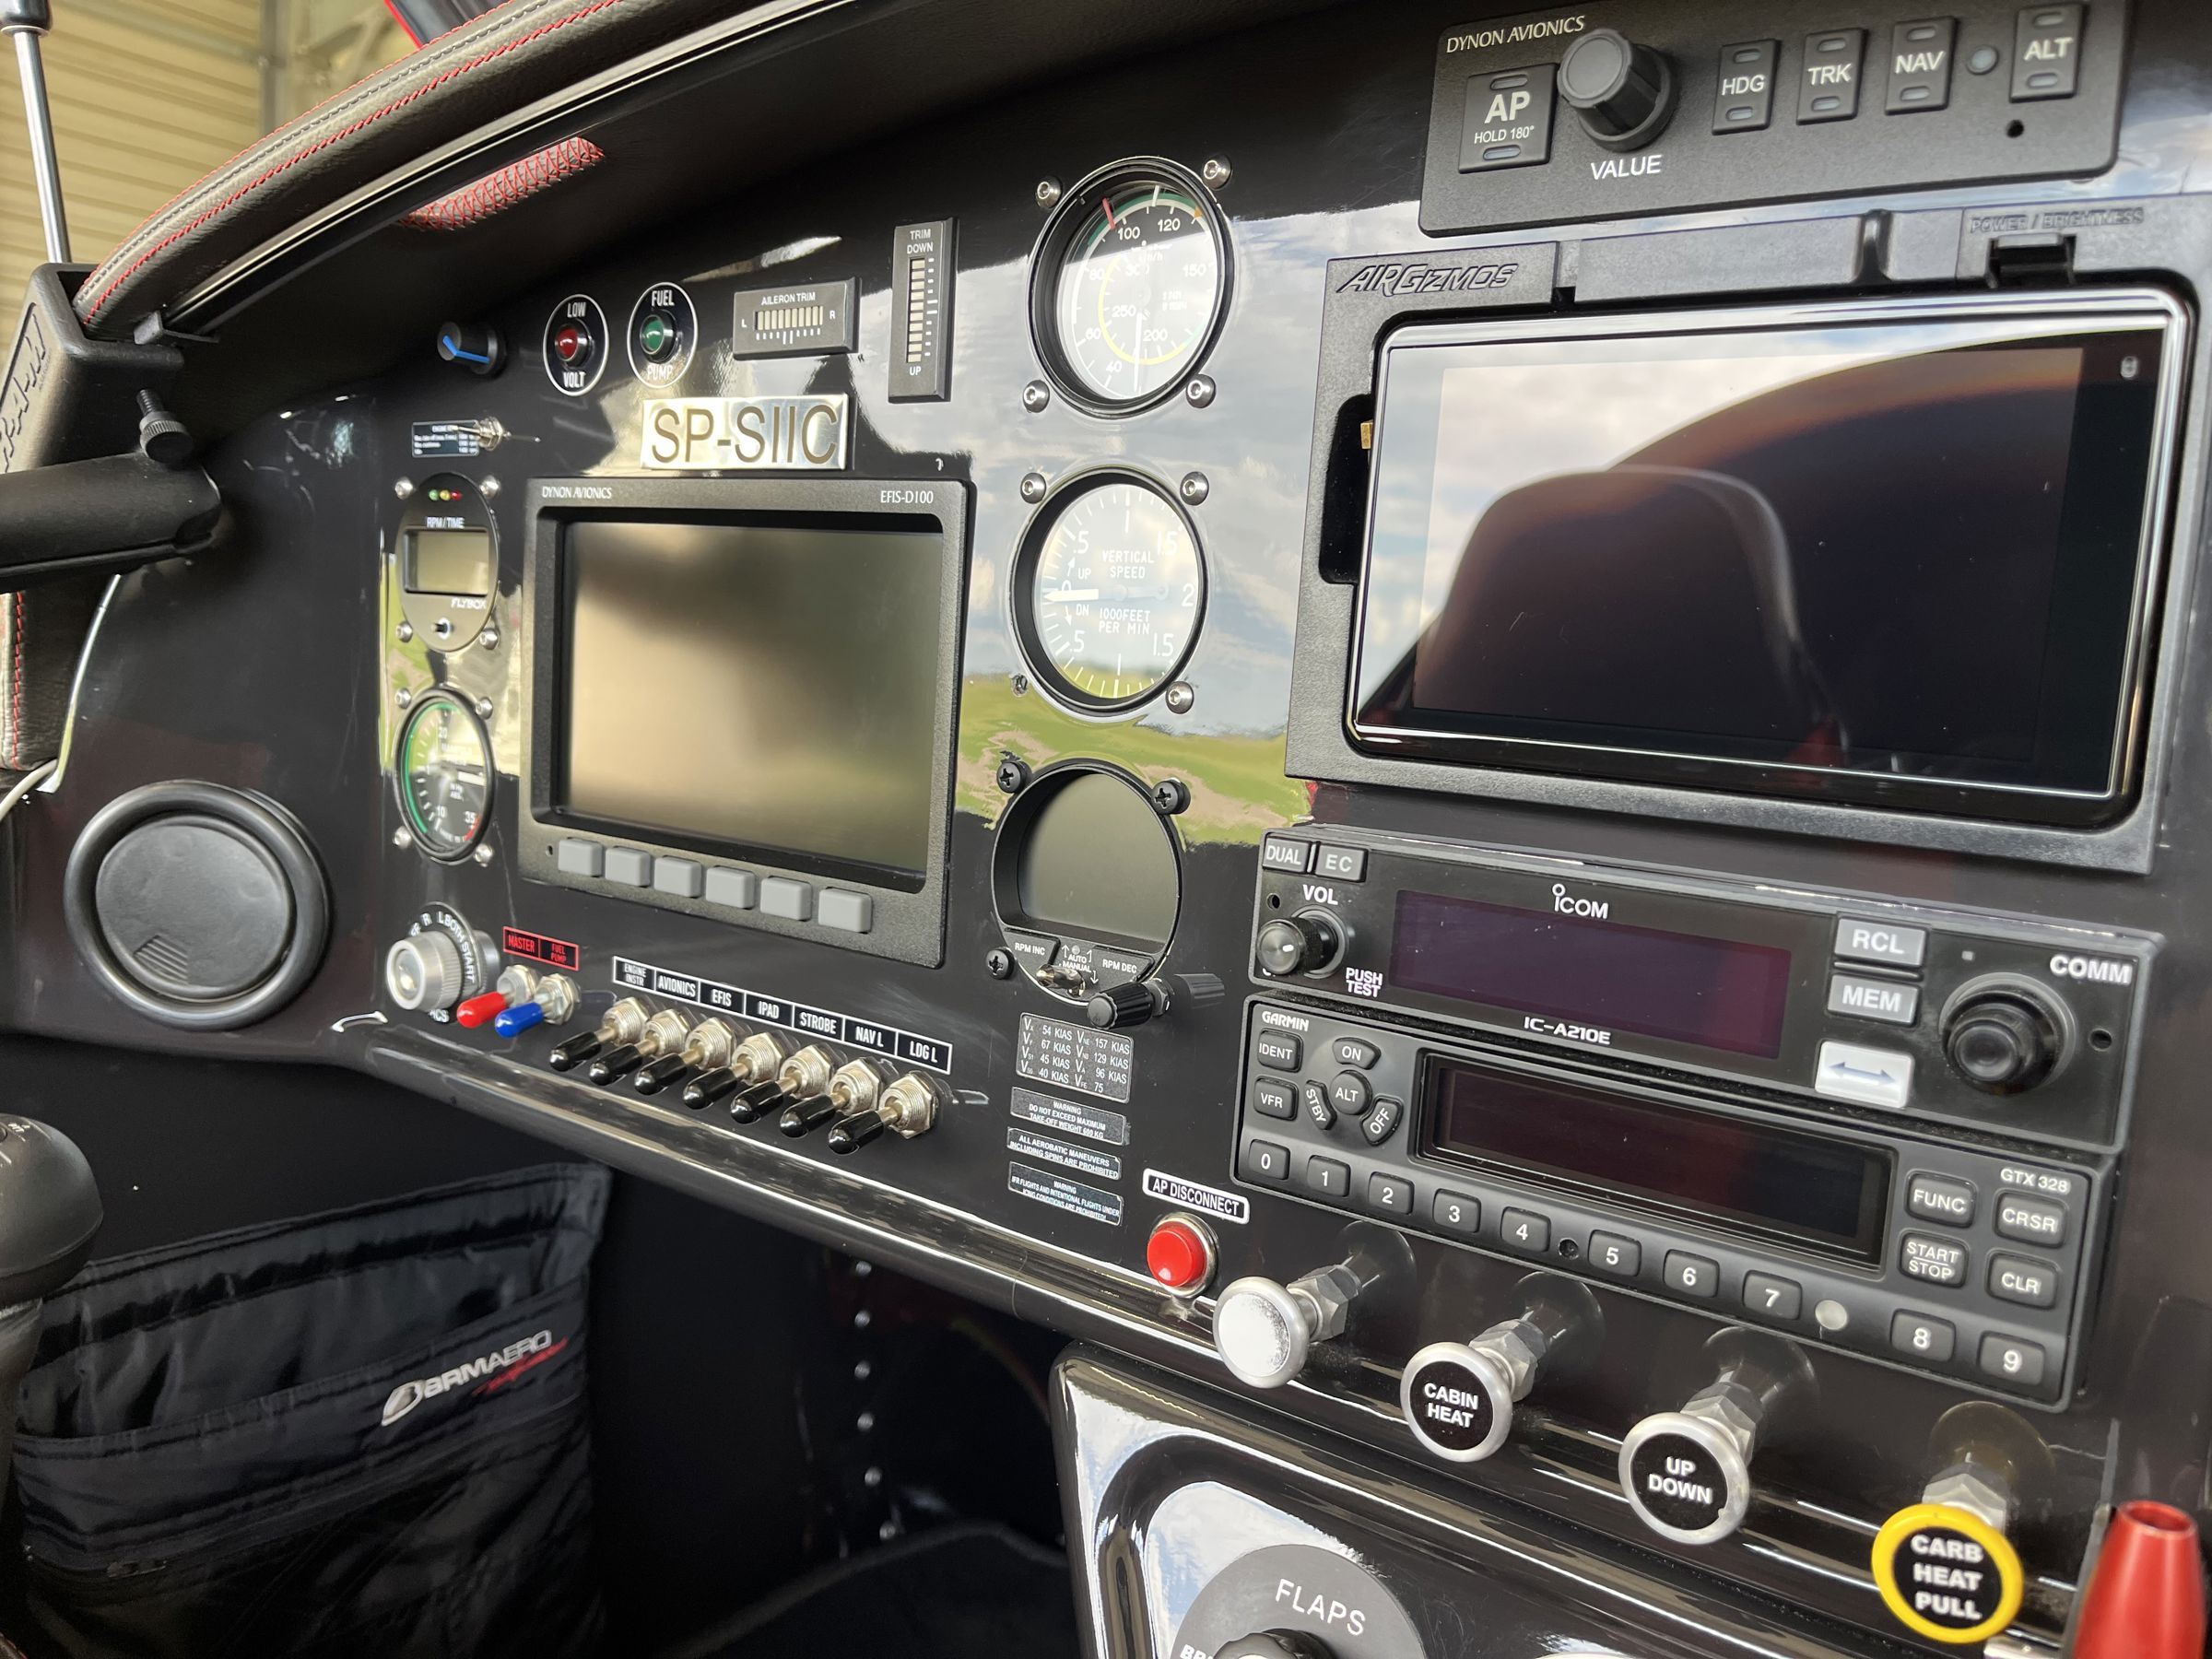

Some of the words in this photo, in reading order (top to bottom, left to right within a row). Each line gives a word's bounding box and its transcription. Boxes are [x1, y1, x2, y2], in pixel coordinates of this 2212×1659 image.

[1446, 29, 1504, 53] DYNON
[1507, 16, 1585, 44] AVIONICS
[2024, 37, 2073, 61] ALT
[1895, 51, 1946, 74] NAV
[1808, 64, 1852, 85] TRK
[1722, 75, 1765, 95] HDG
[1484, 91, 1531, 124] AP
[1474, 129, 1506, 144] HOLD
[1510, 125, 1535, 140] 180°
[1590, 155, 1662, 180] VALUE
[1158, 219, 1181, 234] 120
[1970, 215, 2028, 232] POWER
[2041, 207, 2145, 229] BRIGHTNESS
[910, 229, 931, 240] TRIM
[1118, 226, 1140, 241] 100
[906, 241, 934, 253] DOWN
[1182, 264, 1206, 276] 150
[652, 290, 675, 307] FUEL
[761, 293, 796, 306] AILERON
[796, 291, 816, 303] TRIM
[567, 302, 586, 317] LOW
[830, 311, 836, 320] R
[1112, 306, 1135, 318] 250
[741, 318, 747, 328] L
[1143, 329, 1168, 341] 200
[561, 371, 586, 388] VOLT
[646, 364, 674, 381] PUMP
[909, 366, 922, 376] UP
[651, 404, 838, 465] SP-SIIC
[541, 486, 571, 499] DYNON
[572, 487, 612, 500] AVIONICS
[880, 489, 934, 505] EFIS-D100
[1157, 531, 1177, 556] 1.5
[1102, 550, 1154, 563] VERTICAL
[1078, 568, 1091, 580] UP
[1111, 567, 1145, 579] SPEED
[451, 598, 487, 609] FLYBOX
[1182, 583, 1194, 606] 2
[1076, 604, 1089, 616] DN
[1099, 621, 1120, 634] PER
[1127, 622, 1150, 635] MIN
[1153, 633, 1174, 657] 1.5
[1266, 845, 1301, 865] DUAL
[1303, 885, 1338, 905] VOL
[443, 914, 465, 943] BOTH
[508, 935, 535, 953] MASTER
[552, 944, 566, 955] FUEL
[1015, 942, 1031, 954] RPM
[1031, 945, 1046, 956] INC
[1852, 928, 1905, 955] RCL
[550, 951, 567, 963] PUMP
[1062, 960, 1092, 973] MANUAL
[1068, 953, 1087, 964] AUTO
[1102, 959, 1121, 971] RPM
[1122, 963, 1137, 974] DEC
[624, 963, 647, 978] ENGINE
[1346, 967, 1382, 985] PUSH
[2049, 954, 2133, 985] COMM
[625, 974, 644, 986] INSTR
[658, 975, 696, 997] AVIONICS
[1347, 980, 1381, 997] TEST
[712, 989, 732, 1006] EFIS
[1842, 985, 1901, 1012] MEM
[758, 1000, 779, 1019] IPAD
[800, 1011, 837, 1034] STROBE
[1262, 1011, 1309, 1031] GARMIN
[855, 1026, 876, 1045] NAV
[1042, 1025, 1051, 1035] 54
[1055, 1028, 1073, 1041] KIAS
[1095, 1038, 1108, 1049] 157
[1112, 1041, 1130, 1054] KIAS
[1524, 1017, 1611, 1045] IC-A210E
[910, 1041, 929, 1060] LDG
[931, 1047, 937, 1063] L
[1041, 1040, 1050, 1049] 67
[1053, 1042, 1071, 1055] KIAS
[1094, 1053, 1106, 1064] 129
[1110, 1056, 1128, 1069] KIAS
[1259, 1043, 1292, 1060] IDENT
[1342, 1046, 1361, 1060] ON
[1041, 1053, 1049, 1064] 45
[1053, 1056, 1070, 1069] KIAS
[1096, 1068, 1104, 1078] 96
[1109, 1071, 1126, 1084] KIAS
[1039, 1068, 1048, 1078] 40
[1052, 1071, 1068, 1084] KIAS
[1095, 1082, 1103, 1093] 75
[1261, 1093, 1283, 1108] VFR
[1335, 1088, 1359, 1101] ALT
[1053, 1100, 1081, 1115] WARNING
[1306, 1088, 1326, 1123] STBY
[1039, 1106, 1051, 1116] NOT
[1052, 1110, 1076, 1122] EXCEED
[1077, 1116, 1106, 1131] MAXIMUM
[1371, 1108, 1390, 1134] OFF
[1059, 1120, 1082, 1134] WEIGHT
[1094, 1130, 1103, 1139] KG
[1009, 1141, 1043, 1157] INCLUDING
[1043, 1151, 1064, 1162] SPINS
[1064, 1157, 1077, 1167] ARE
[1078, 1160, 1118, 1179] PROHIBITED
[1018, 1135, 1030, 1144] ALL
[1031, 1138, 1068, 1155] AEROBATIC
[1069, 1149, 1110, 1167] MANEUVERS
[1261, 1153, 1271, 1170] 0
[1053, 1181, 1077, 1194] WARNING
[1321, 1171, 1329, 1186] 1
[2000, 1168, 2034, 1186] GTX
[2038, 1176, 2071, 1193] 328
[1153, 1179, 1168, 1193] AP
[1170, 1182, 1239, 1215] DISCONNECT
[1382, 1187, 1394, 1204] 2
[1913, 1189, 1966, 1213] FUNC
[1449, 1206, 1460, 1223] 3
[2002, 1208, 2057, 1232] CRSR
[1516, 1224, 1528, 1241] 4
[1606, 1247, 1618, 1265] 5
[1907, 1241, 1959, 1263] START
[1682, 1267, 1696, 1286] 6
[1910, 1262, 1953, 1279] STOP
[2002, 1272, 2041, 1295] CLR
[1765, 1288, 1781, 1308] 7
[1912, 1327, 1931, 1349] 8
[2003, 1349, 2022, 1372] 9
[1424, 1382, 1478, 1409] CABIN
[1428, 1403, 1473, 1428] HEAT
[1666, 1456, 1696, 1476] UP
[1648, 1474, 1712, 1504] DOWN
[1911, 1535, 1983, 1563] CARB
[1912, 1564, 1983, 1591] HEAT
[1275, 1578, 1366, 1636] FLAPS
[1915, 1592, 1982, 1619] PULL
